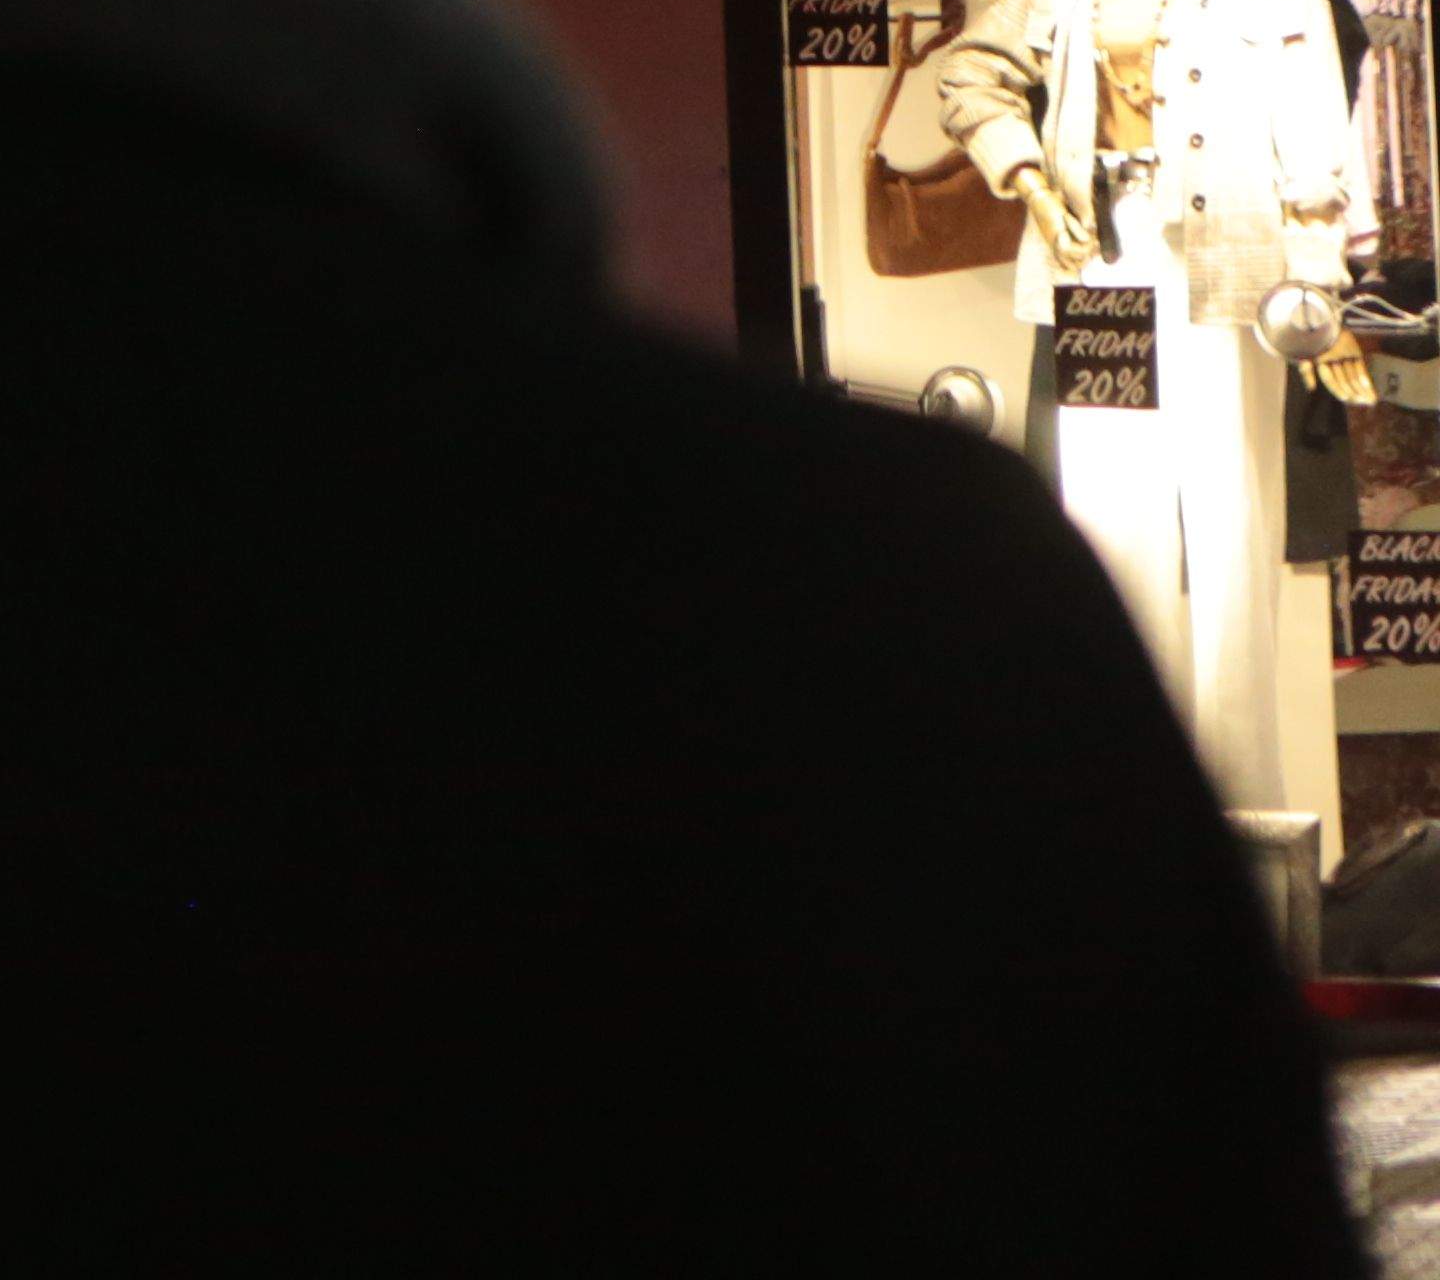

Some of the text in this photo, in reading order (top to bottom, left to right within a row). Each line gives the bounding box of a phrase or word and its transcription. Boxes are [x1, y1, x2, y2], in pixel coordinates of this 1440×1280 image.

[799, 23, 878, 63] 20%
[1065, 287, 1155, 318] BLACK
[1054, 327, 1156, 359] FRIDAY
[1066, 366, 1148, 406] 20%
[1363, 612, 1440, 654] 20%
